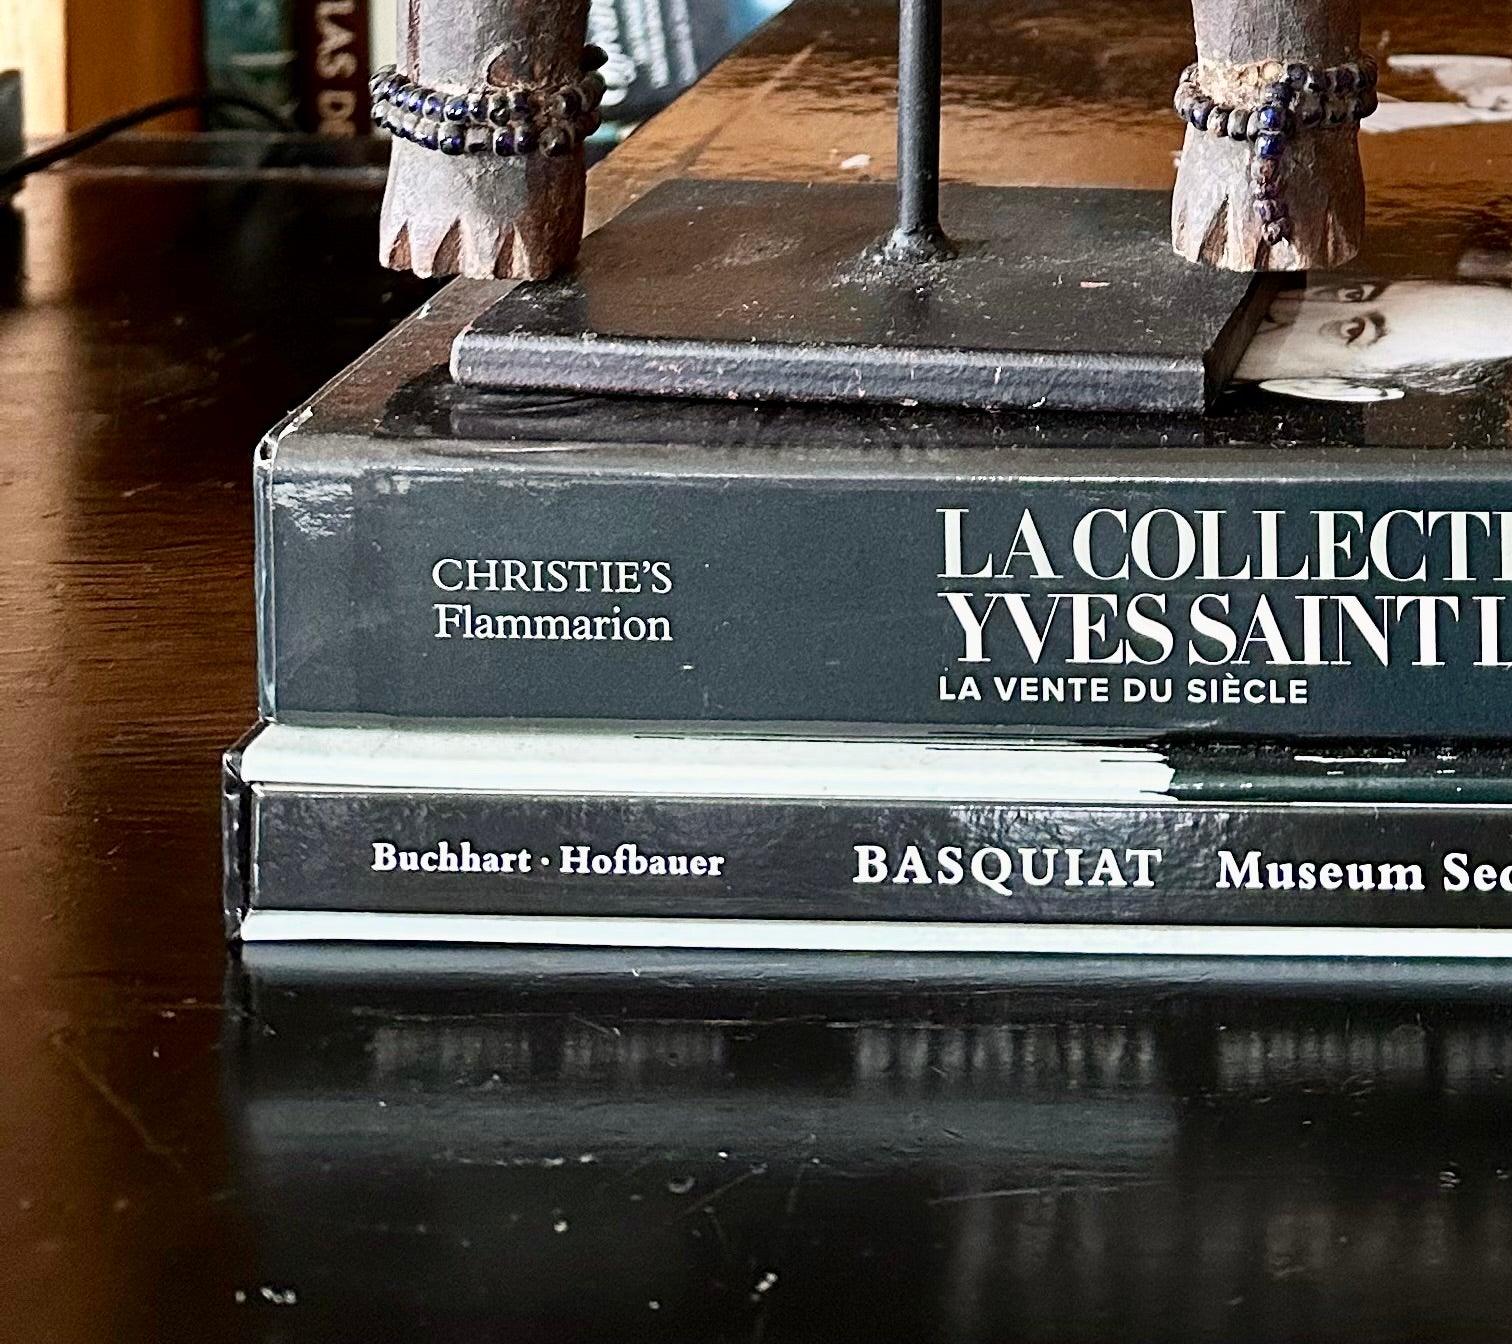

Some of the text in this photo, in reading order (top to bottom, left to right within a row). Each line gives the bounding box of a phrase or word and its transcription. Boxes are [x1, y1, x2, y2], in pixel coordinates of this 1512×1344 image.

[936, 507, 1064, 580] LA
[432, 602, 674, 642] Flammarion
[936, 590, 1176, 668] YVES
[1189, 593, 1461, 669] SAINT
[939, 671, 1309, 706] LA VENTE DU SIÈCLE
[370, 842, 532, 874] Buchhart
[559, 844, 726, 878] Hofbauer
[852, 844, 1165, 897] BASQUIAT
[1215, 849, 1426, 894] Museum
